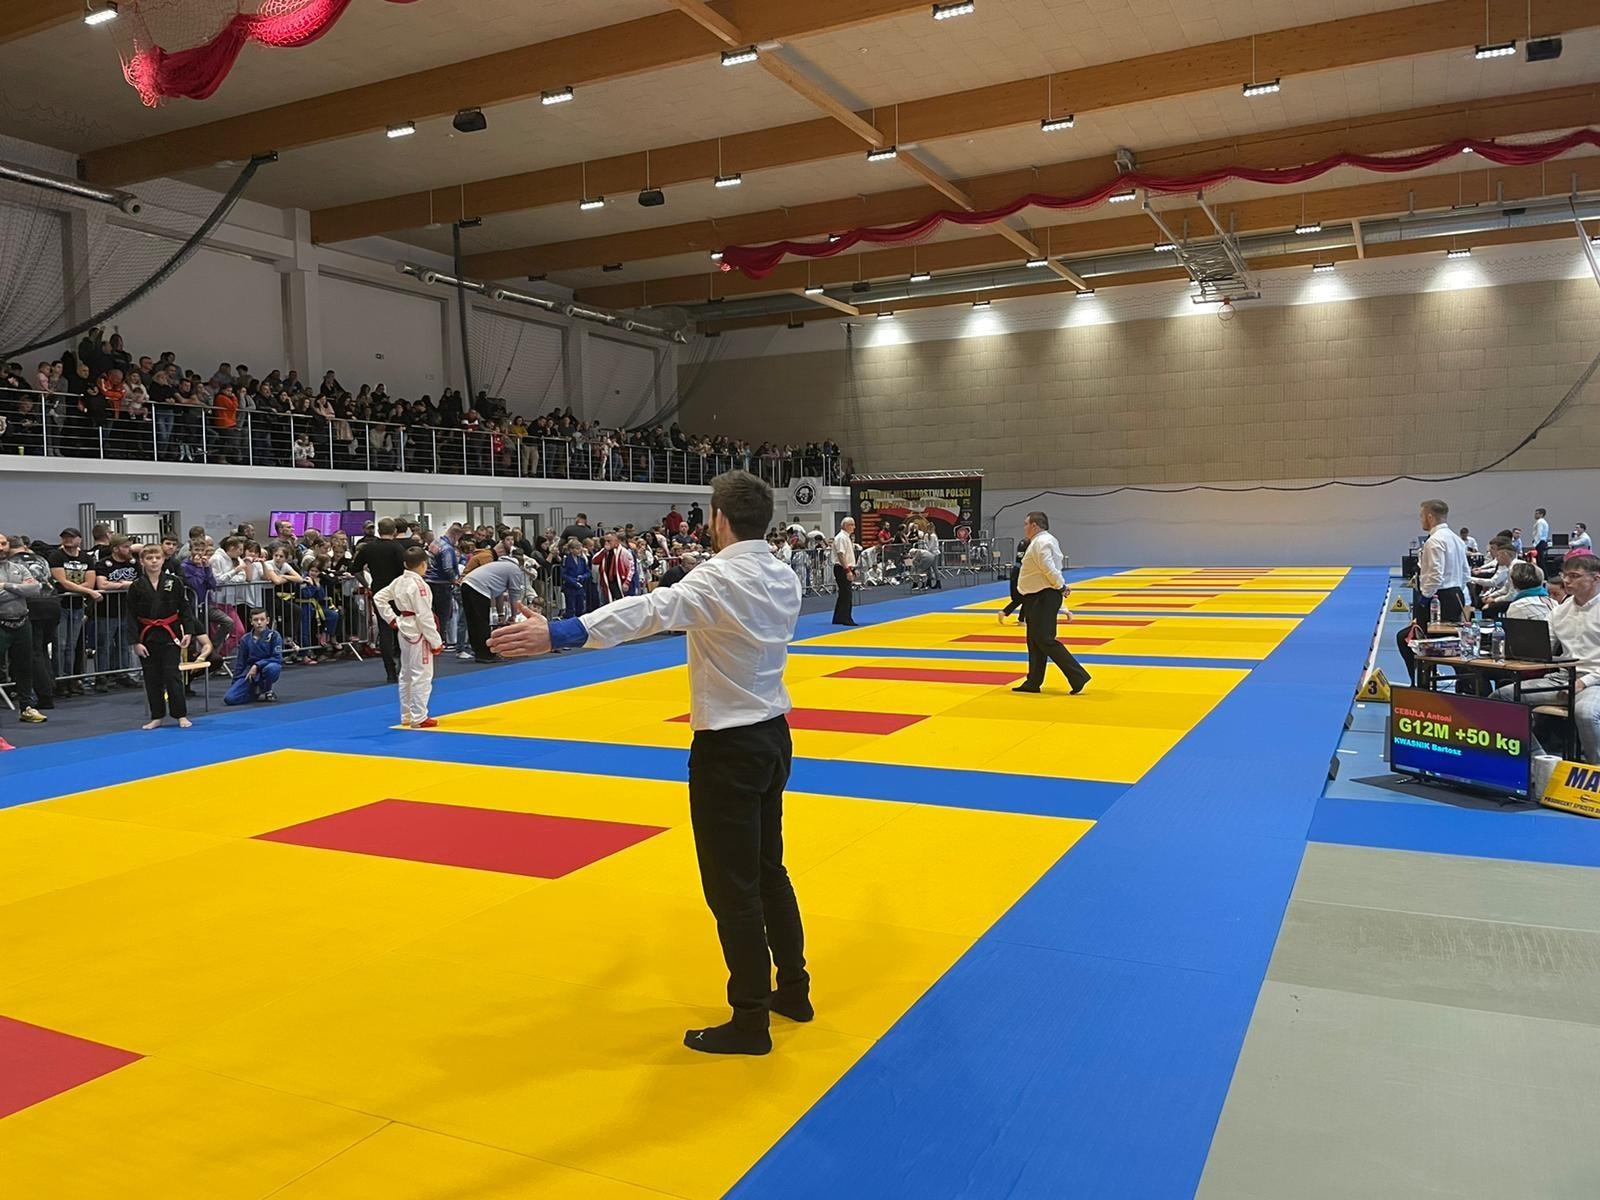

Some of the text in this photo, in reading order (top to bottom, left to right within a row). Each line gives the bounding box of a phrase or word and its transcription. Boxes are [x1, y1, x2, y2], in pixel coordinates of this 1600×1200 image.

[945, 488, 971, 498] POLSKI
[1397, 600, 1402, 608] 5
[1368, 681, 1377, 695] 3
[1394, 707, 1452, 722] CEBULA Antoni
[1399, 718, 1521, 756] G12M +50 kg
[1432, 743, 1462, 756] Bartosz
[1564, 766, 1600, 793] MA
